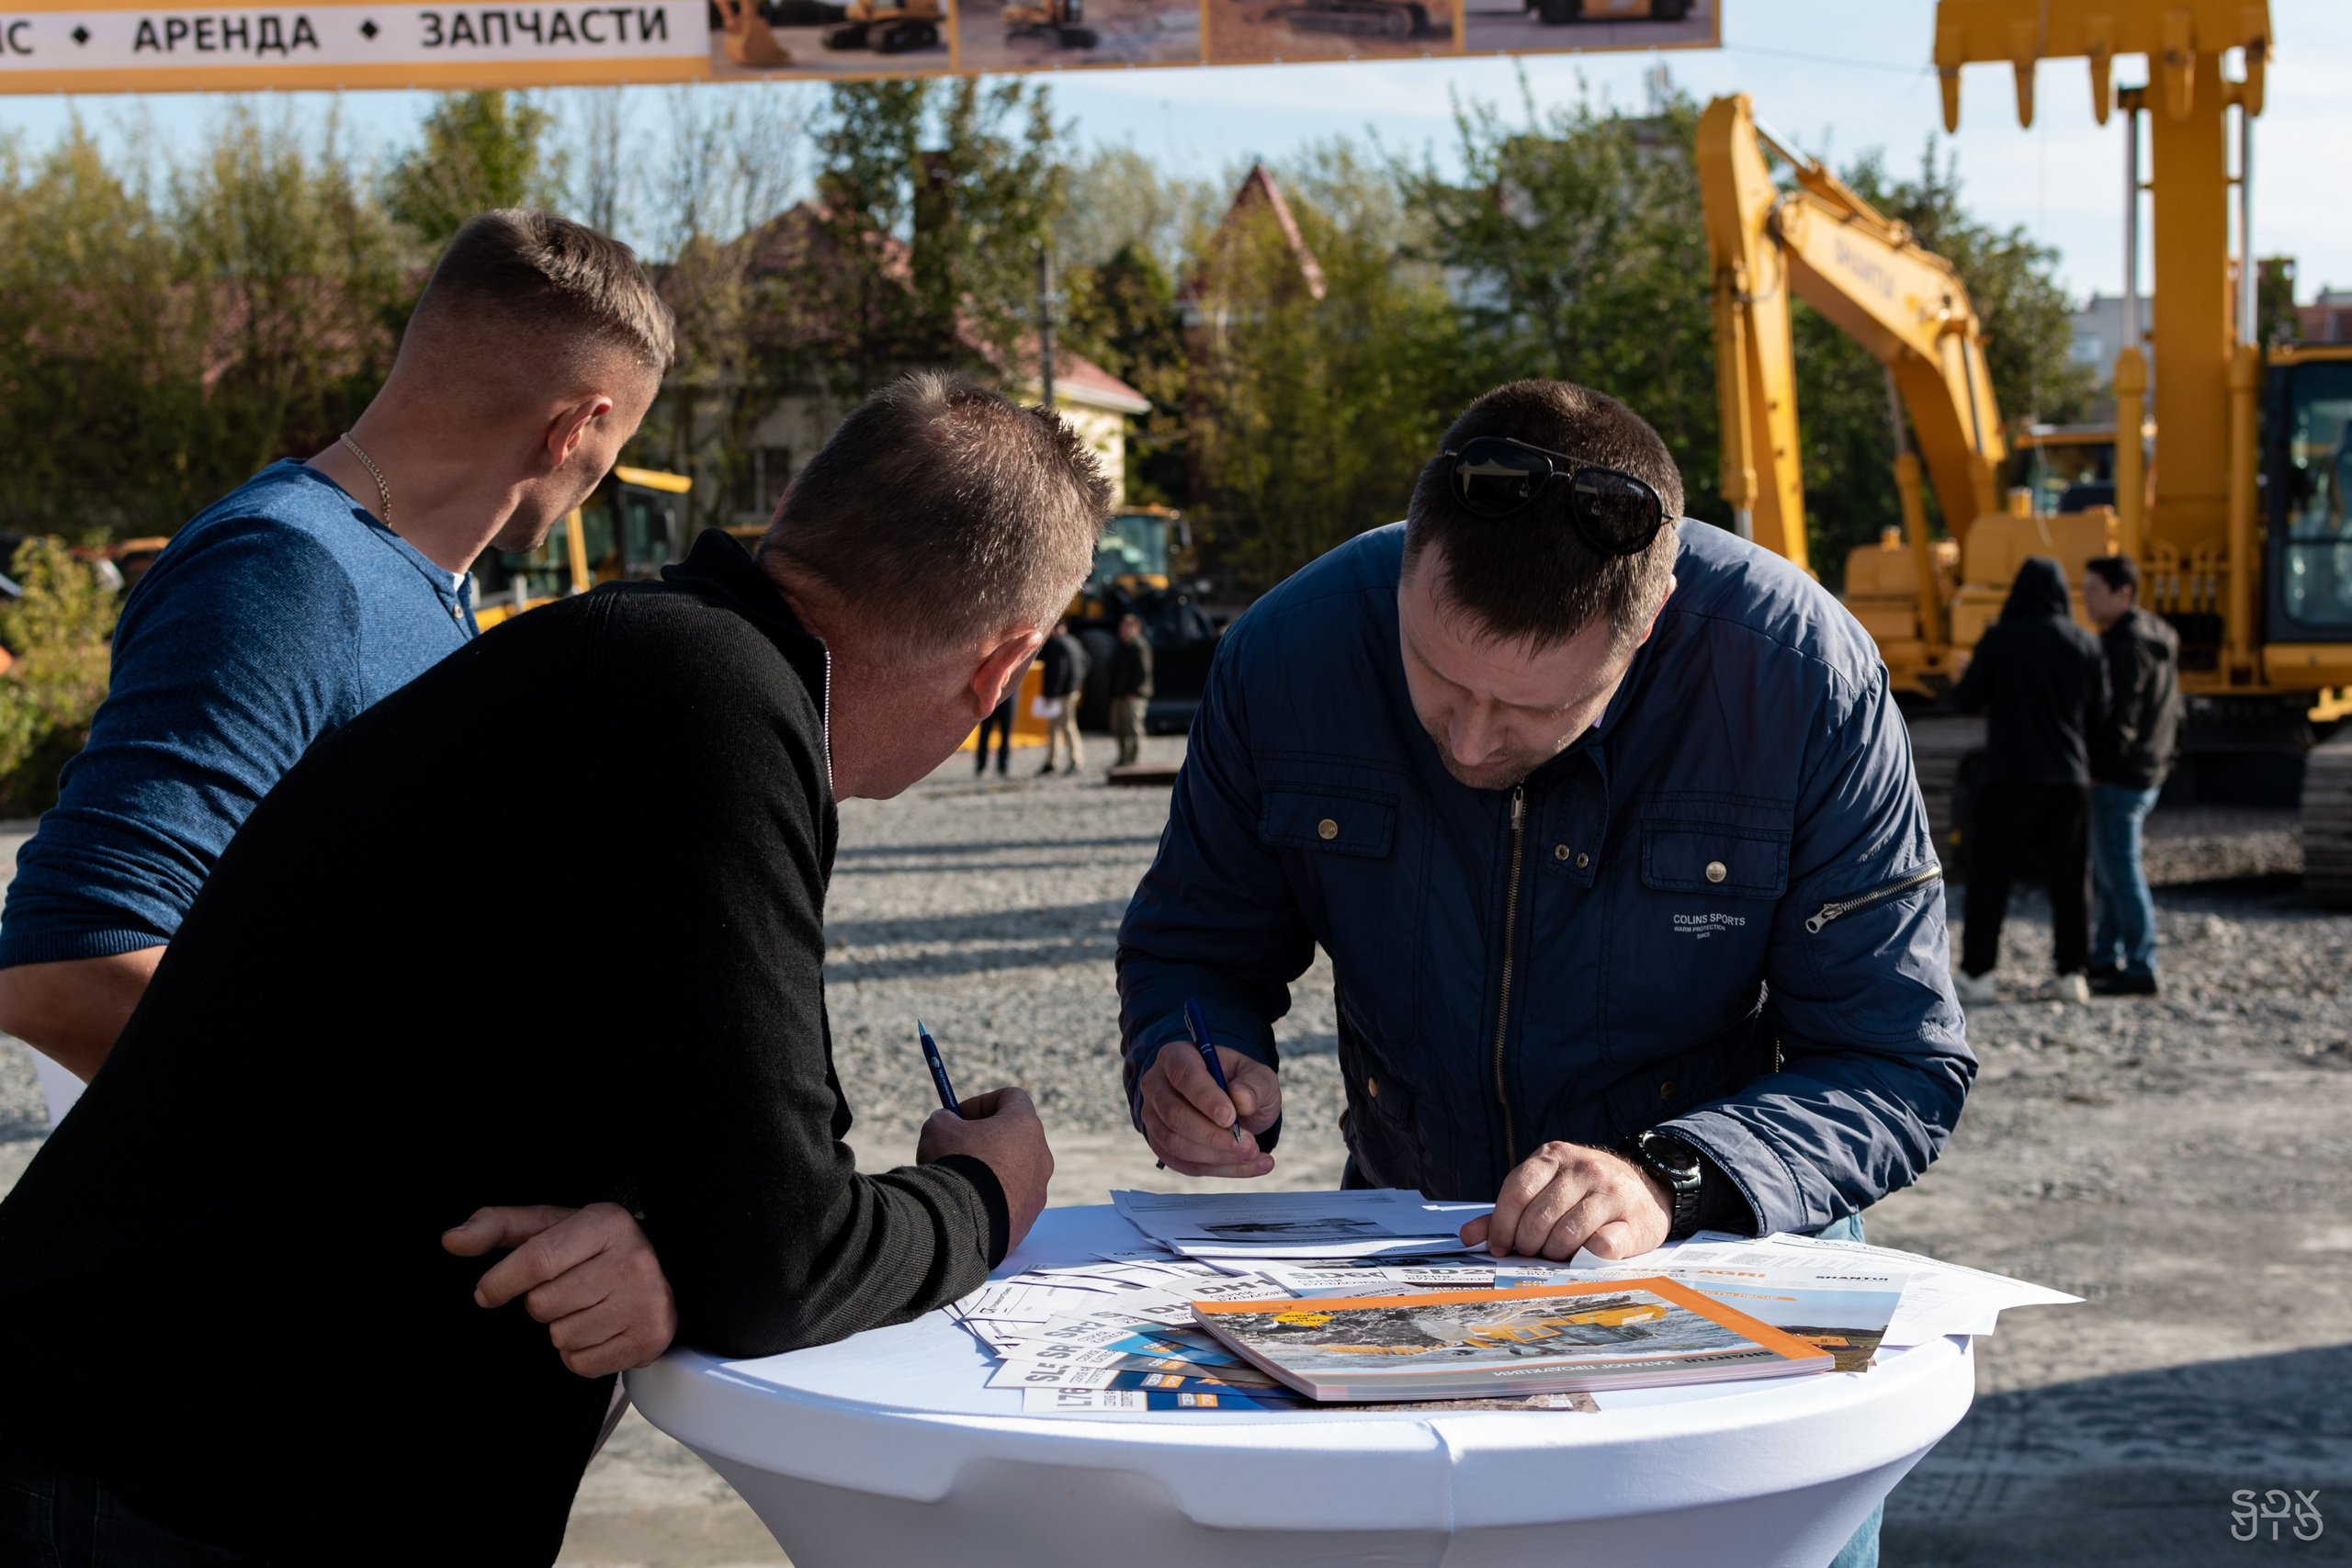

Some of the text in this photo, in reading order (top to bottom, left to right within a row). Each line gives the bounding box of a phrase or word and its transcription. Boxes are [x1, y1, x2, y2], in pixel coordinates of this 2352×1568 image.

[133, 16, 320, 56] АРЕНДА
[420, 7, 671, 48] ЗАПЧАСТИ
[1673, 913, 1746, 926] COLINS SPORTS
[1692, 923, 1726, 932] PROTECTION
[1696, 931, 1711, 940] SINCE
[1696, 1269, 1767, 1279] AGRI
[1492, 1360, 1676, 1377] КАТАЛОГ ПРОДУКЦИИ
